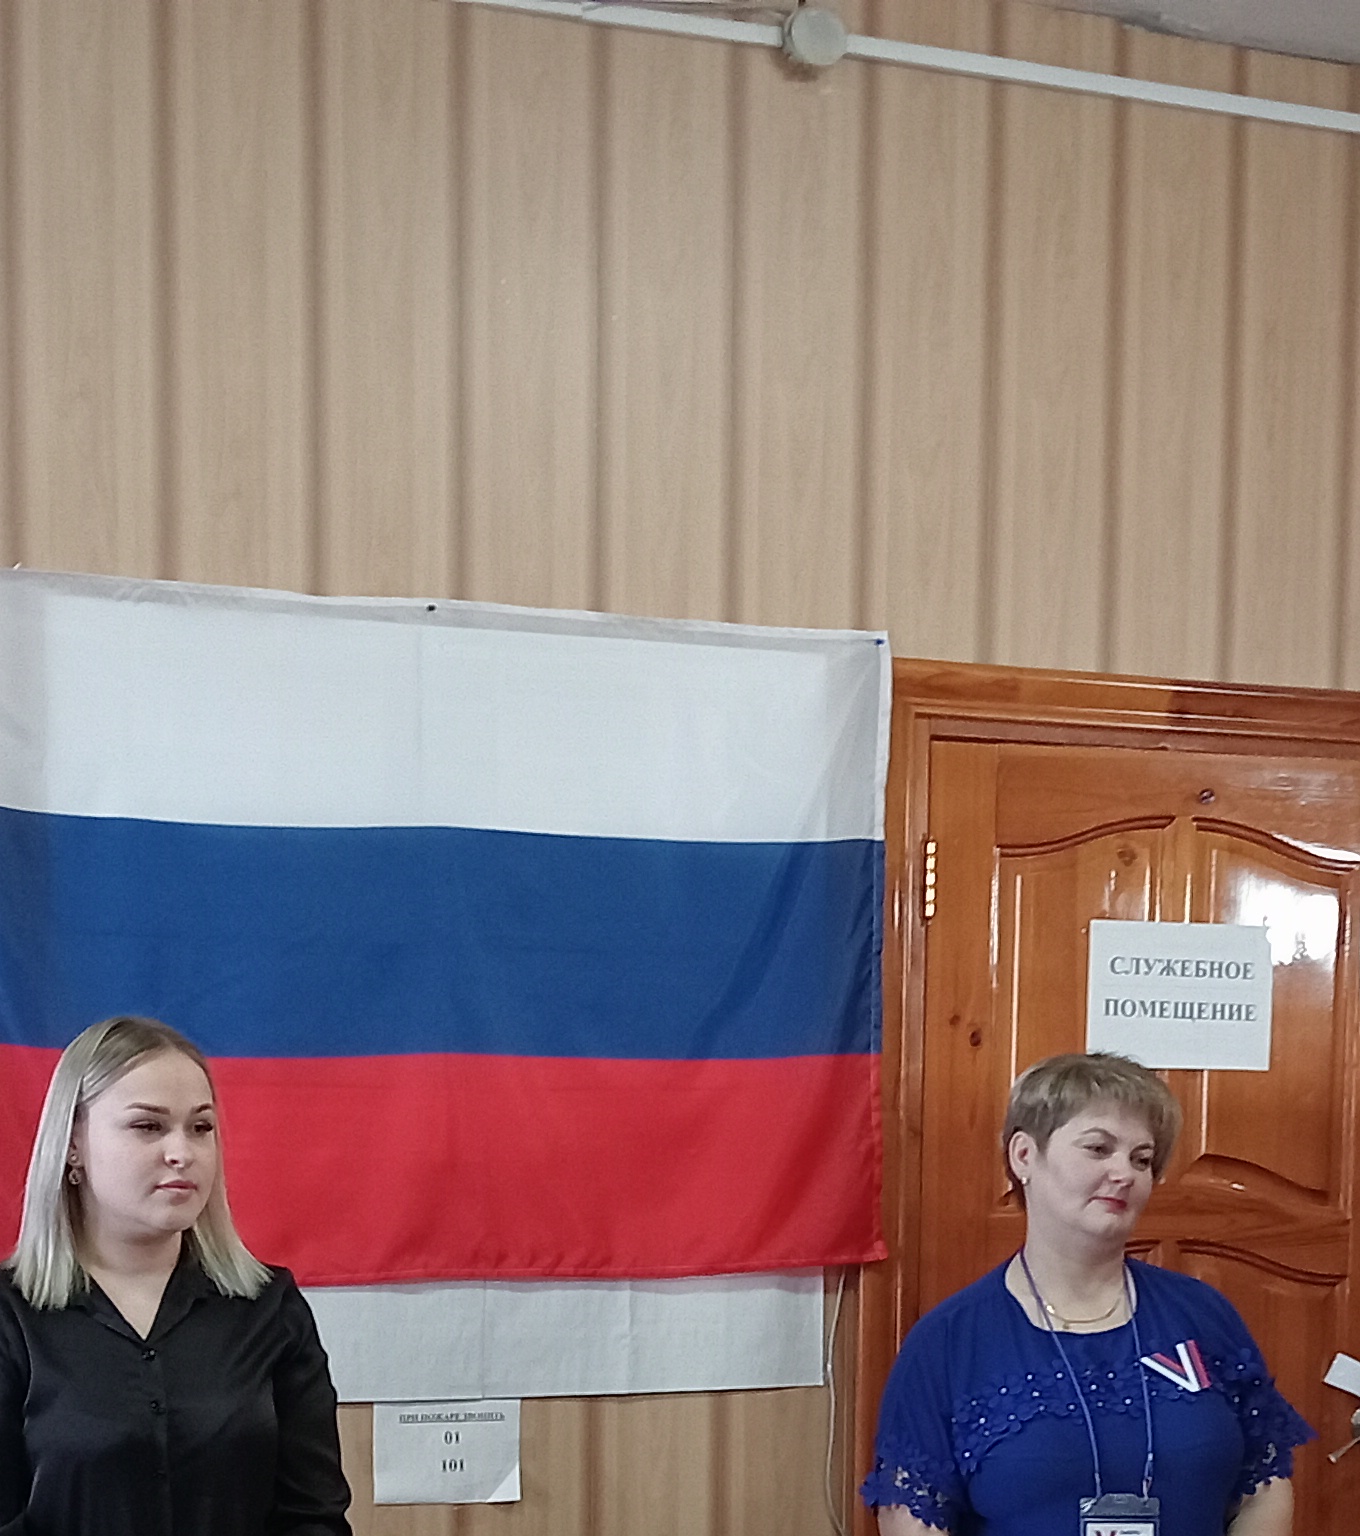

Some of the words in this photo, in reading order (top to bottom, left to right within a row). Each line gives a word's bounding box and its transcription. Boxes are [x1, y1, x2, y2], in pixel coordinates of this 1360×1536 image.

[1108, 955, 1256, 981] СЛУЖЕБНОЕ
[1103, 996, 1258, 1023] ПОМЕЩЕНИЕ
[444, 1431, 461, 1445] 01
[441, 1458, 466, 1473] 101
